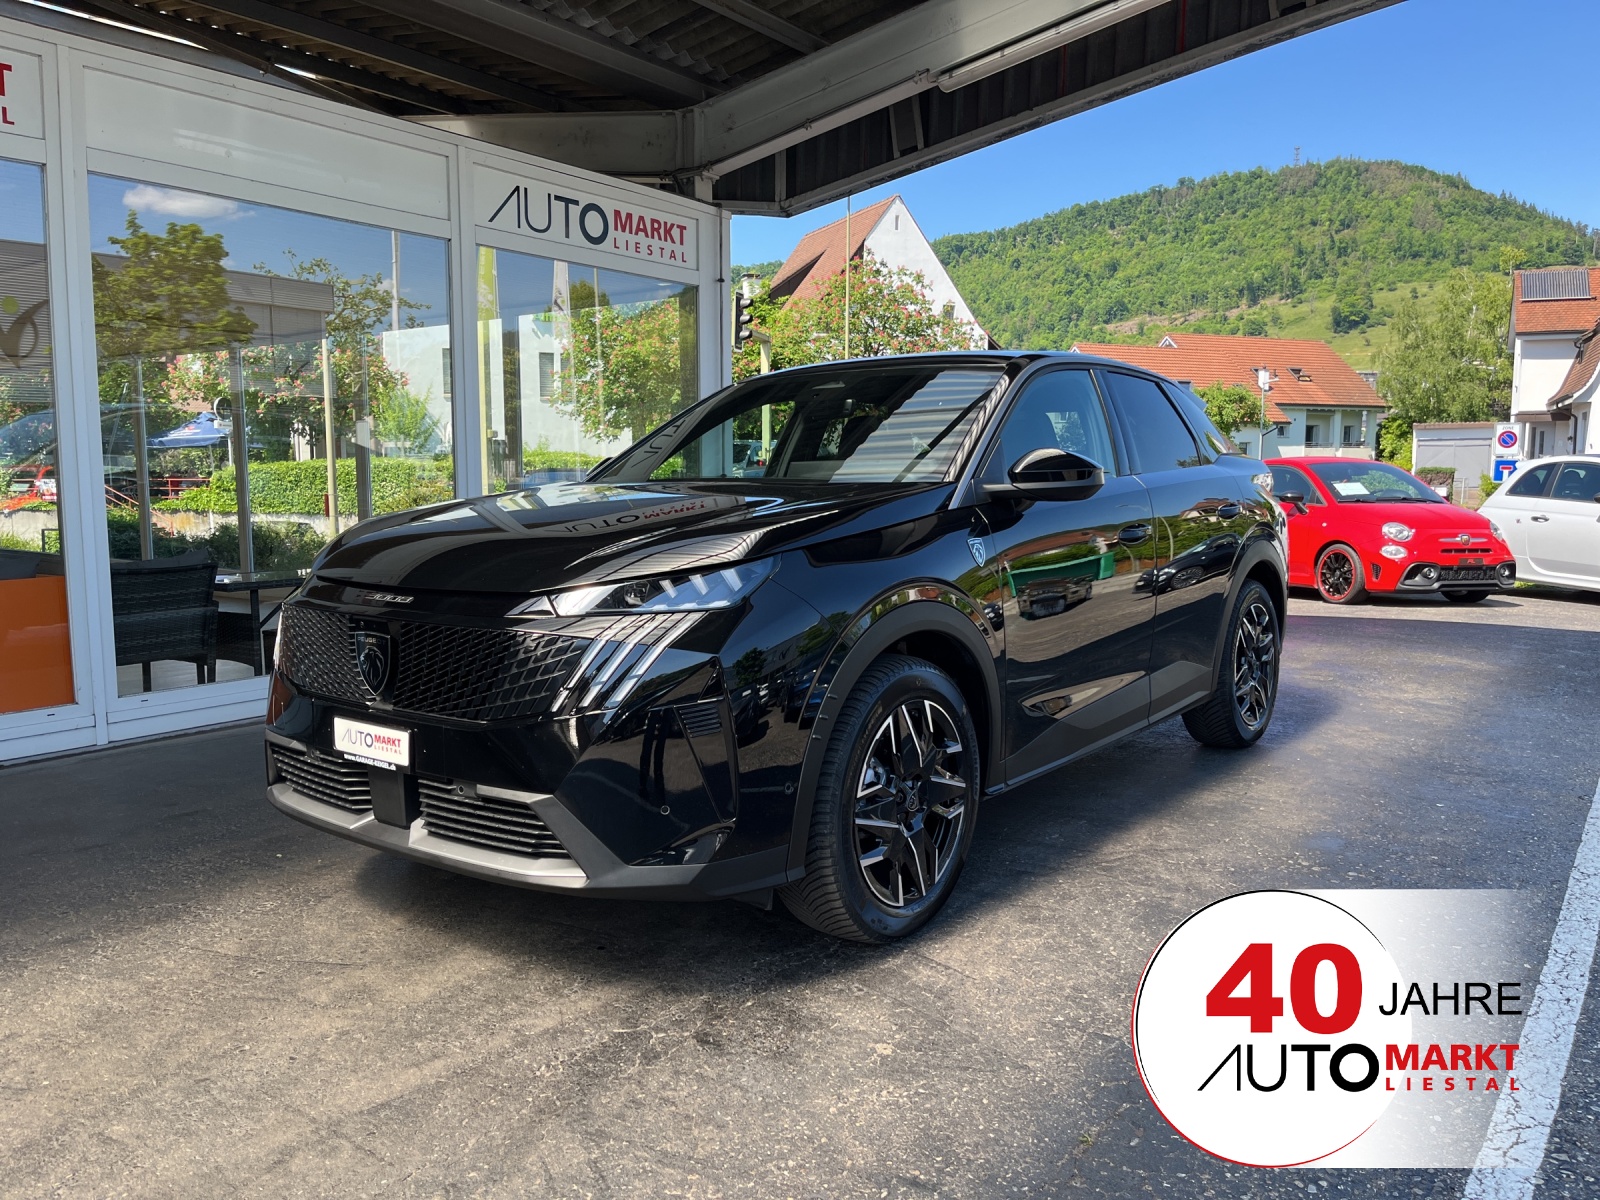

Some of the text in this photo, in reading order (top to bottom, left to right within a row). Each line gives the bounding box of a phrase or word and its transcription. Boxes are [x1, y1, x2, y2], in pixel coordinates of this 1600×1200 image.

[488, 185, 687, 246] AUTO MARKT
[613, 237, 687, 263] LIESTAL
[357, 636, 386, 645] PEUGEOT
[342, 728, 401, 748] AUTO MARKT
[374, 745, 402, 755] LIESTAL
